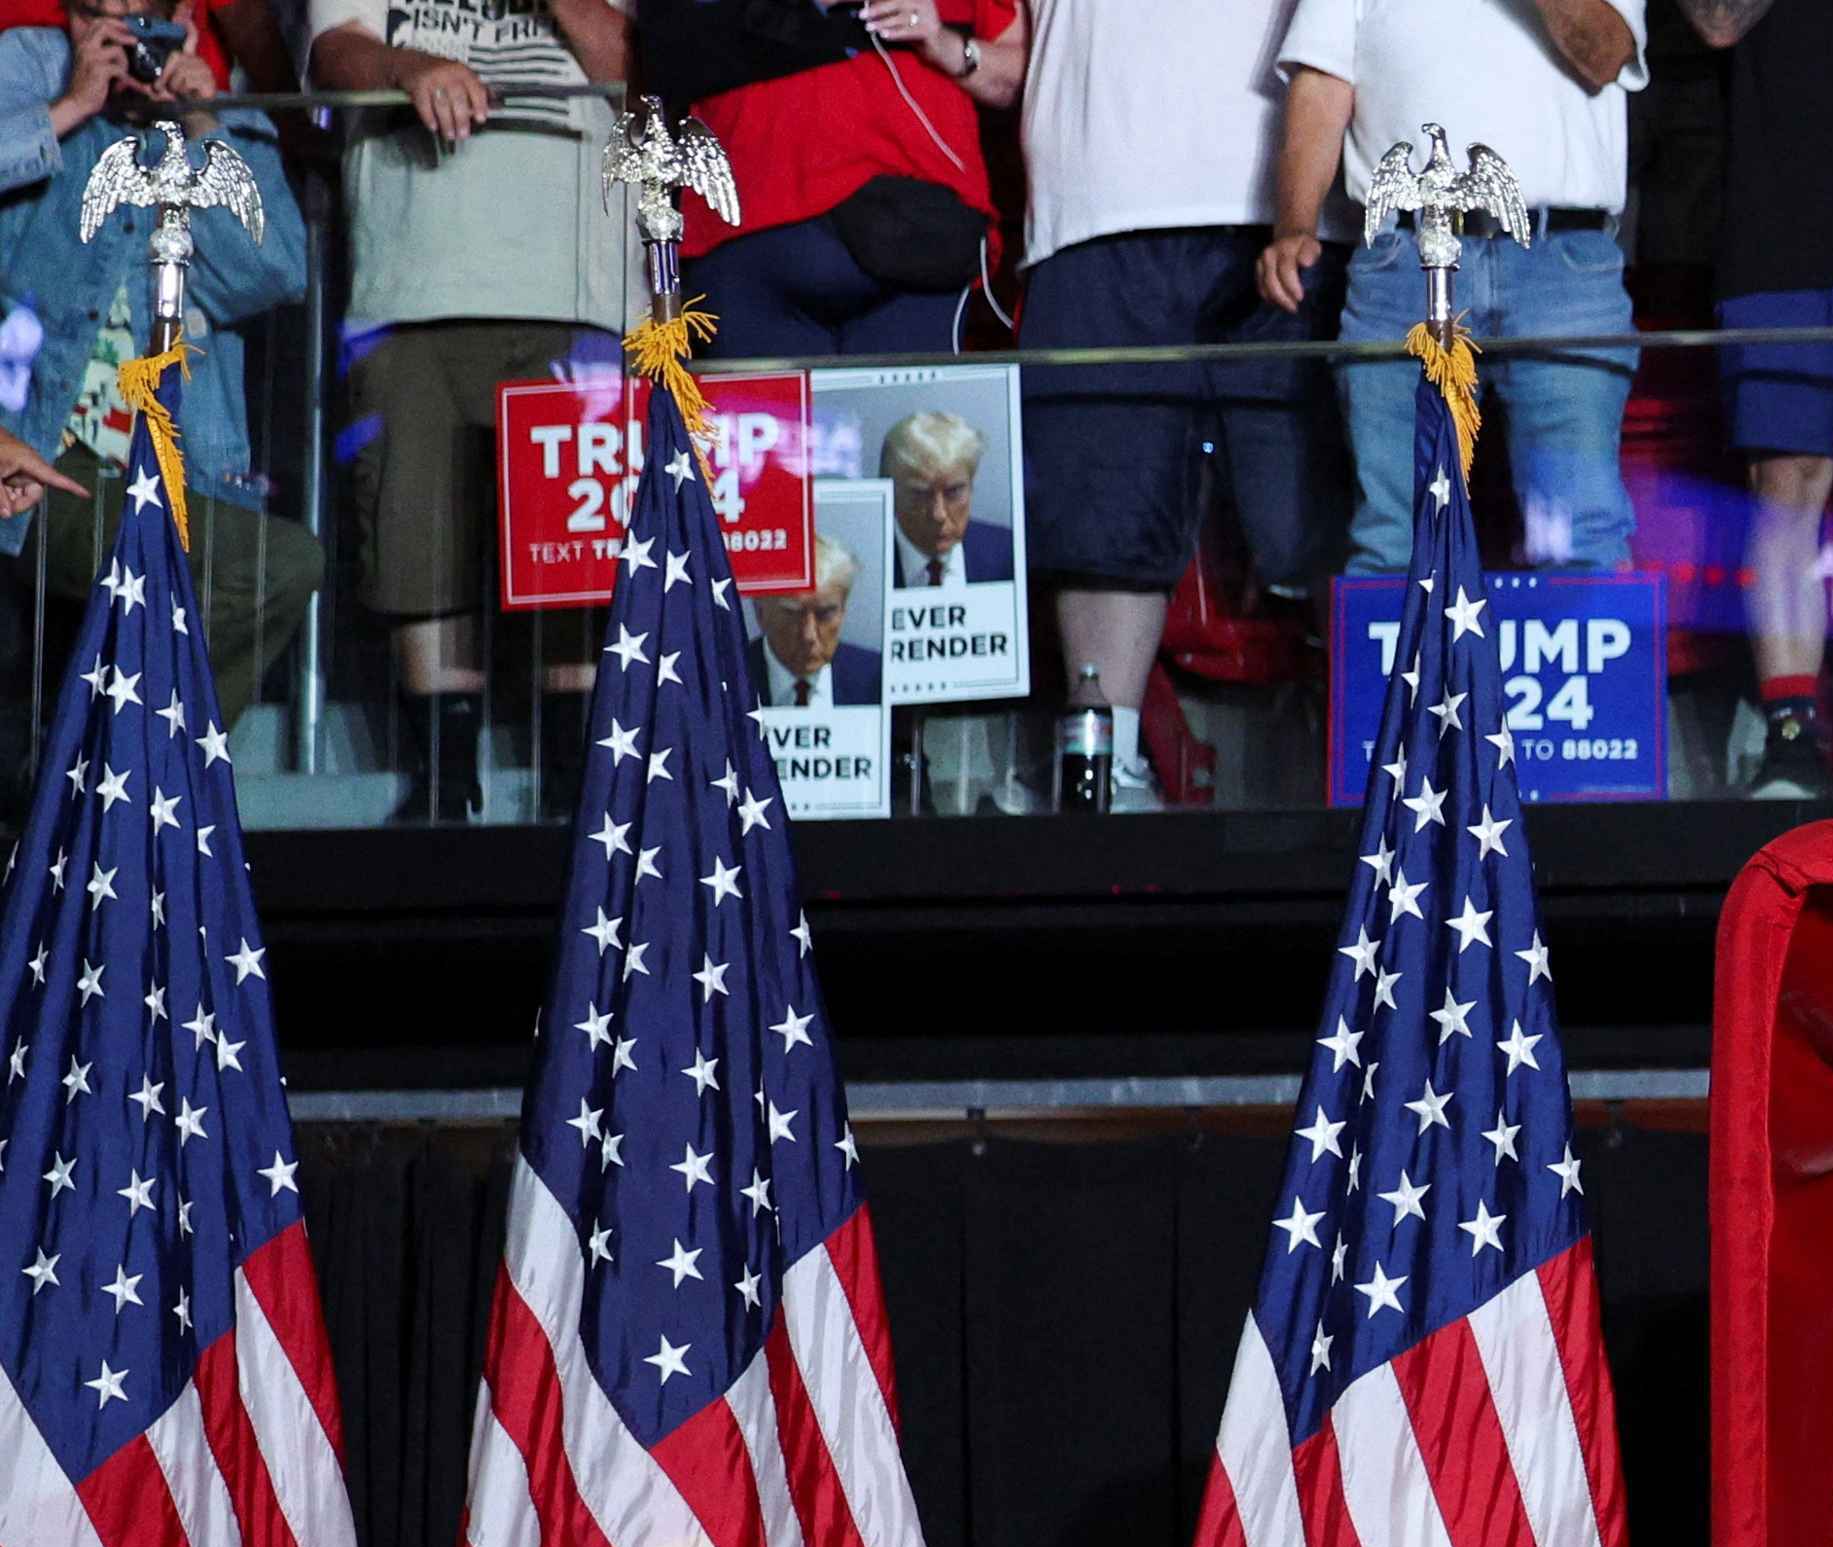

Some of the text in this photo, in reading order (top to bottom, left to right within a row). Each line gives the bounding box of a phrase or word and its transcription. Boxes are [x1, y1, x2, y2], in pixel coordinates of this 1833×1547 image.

[529, 540, 583, 564] TEXT
[891, 605, 967, 631] EVER
[890, 633, 1009, 663] RENDER
[1503, 674, 1595, 731] 24
[772, 726, 832, 749] VER
[1521, 738, 1638, 761] TO 88022
[776, 756, 872, 781] ENDER
